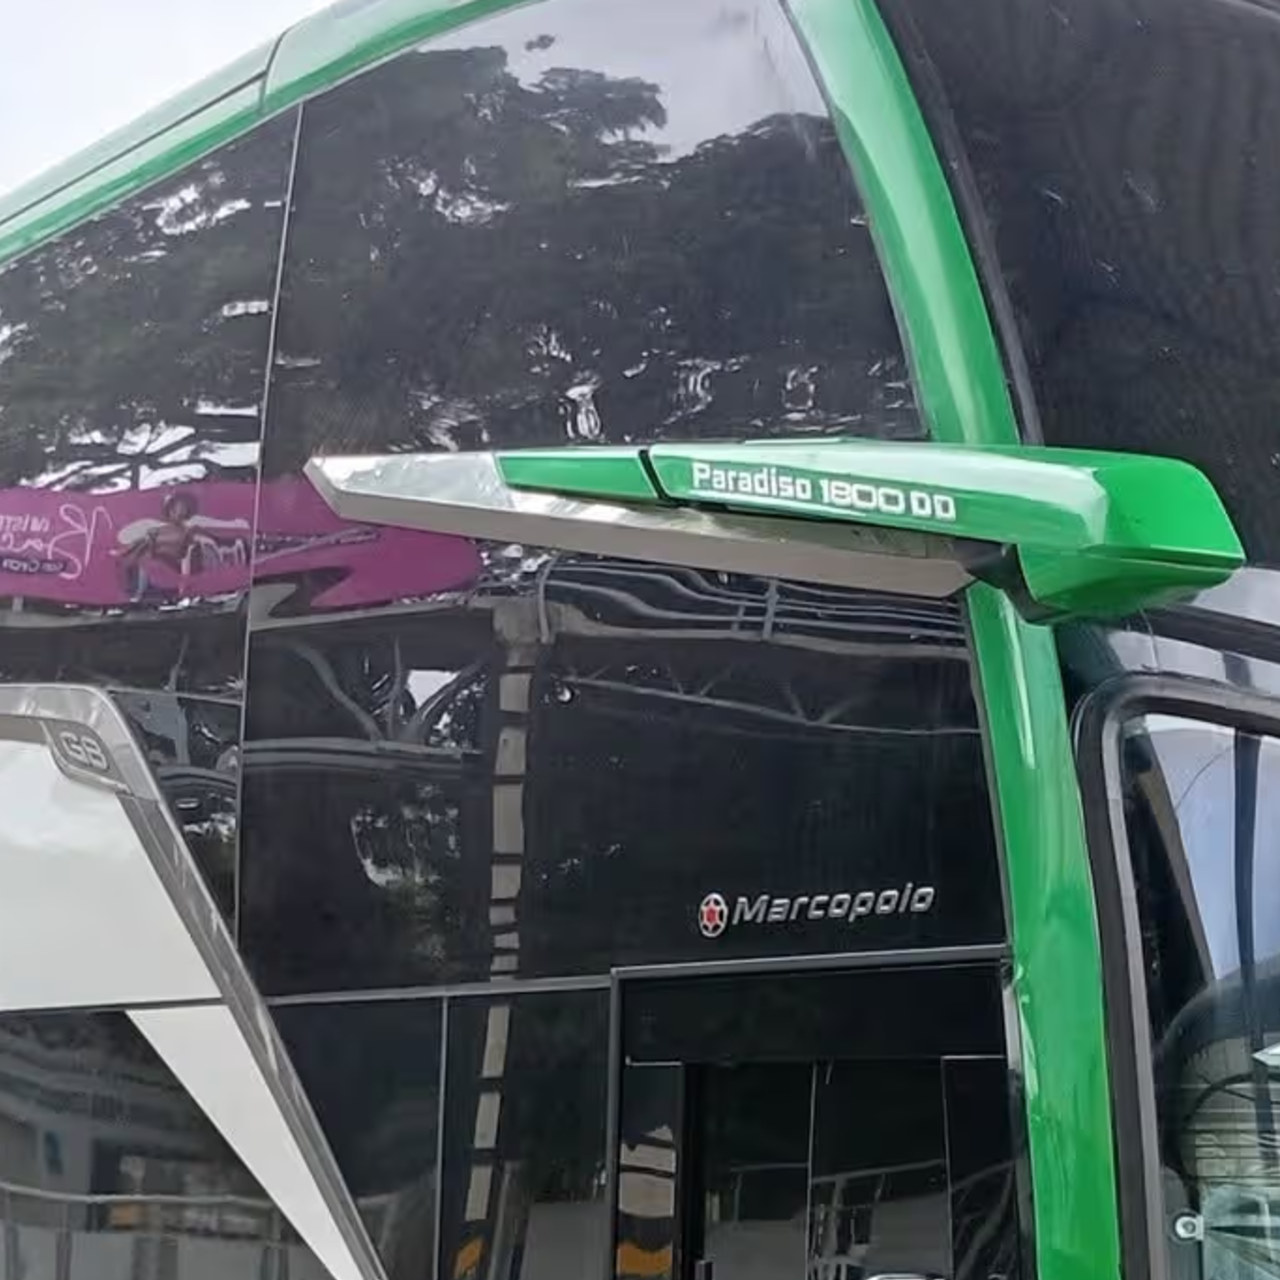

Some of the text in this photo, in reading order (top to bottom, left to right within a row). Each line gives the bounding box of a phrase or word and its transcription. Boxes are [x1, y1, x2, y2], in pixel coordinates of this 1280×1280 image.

[692, 461, 957, 521] Paradiso 1800 DD
[731, 882, 936, 925] Marcopolo
